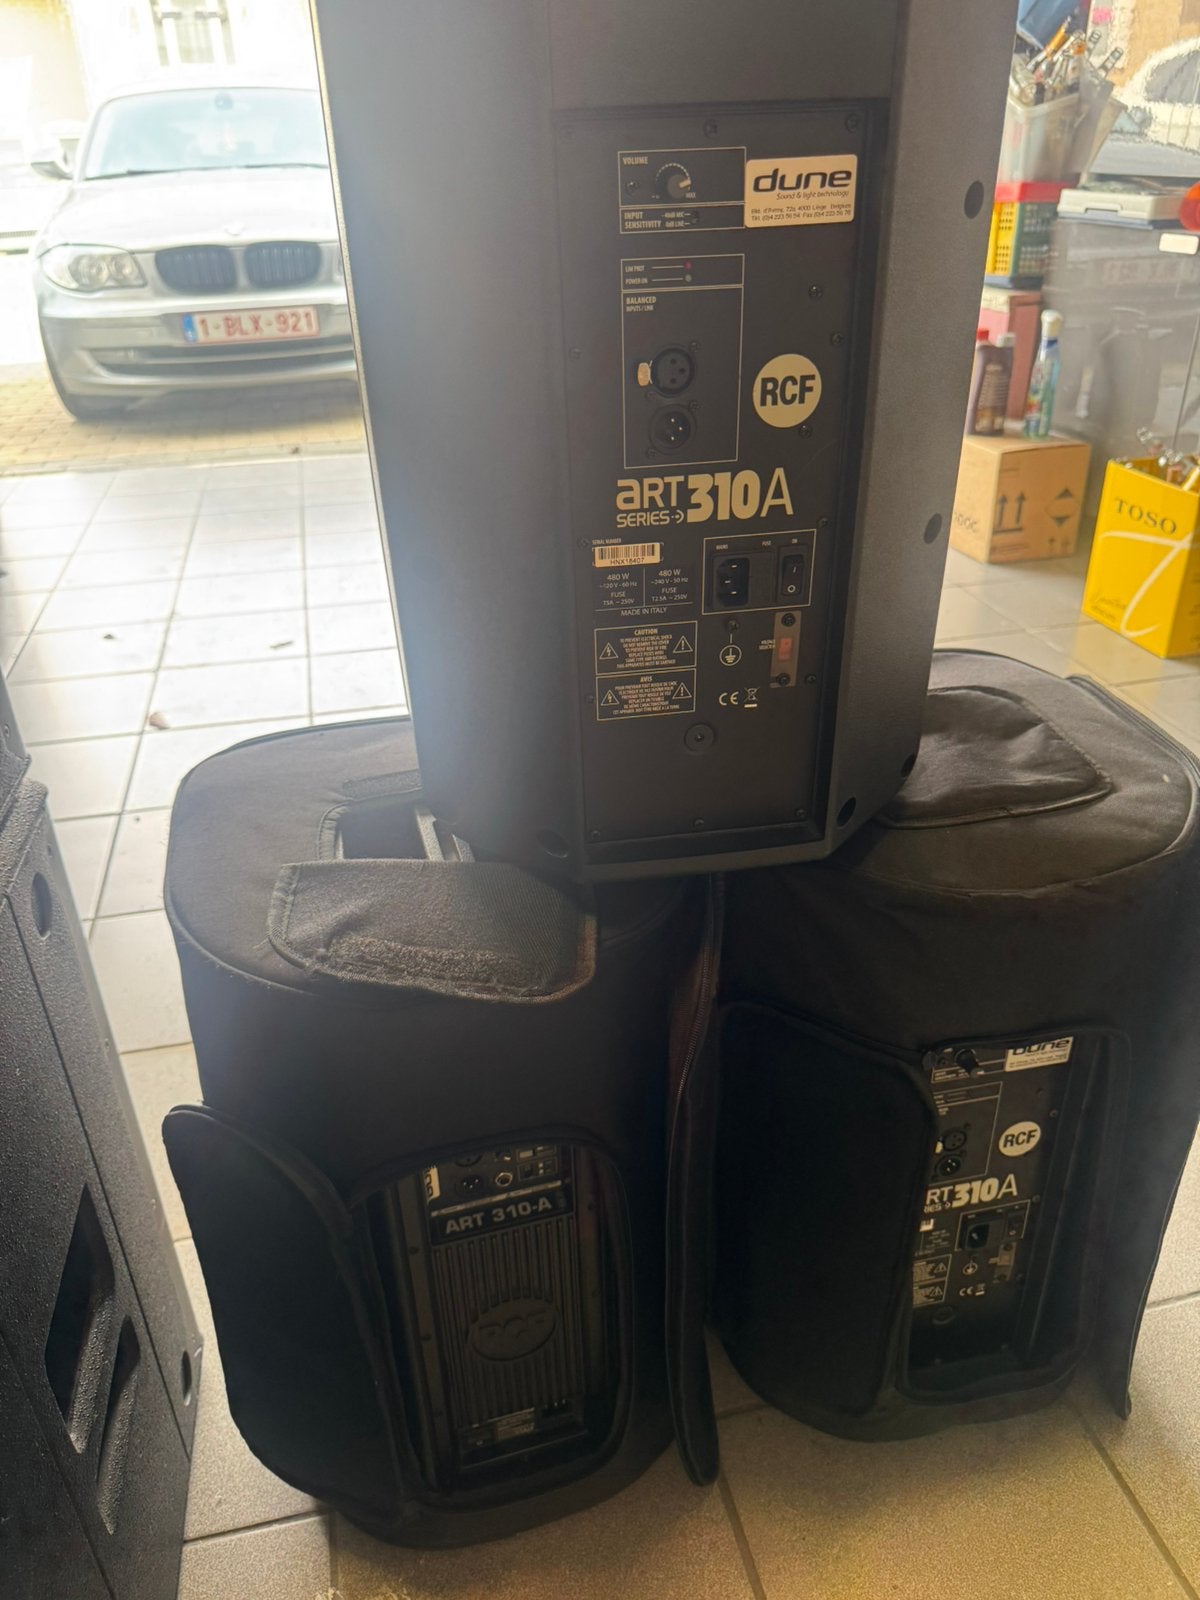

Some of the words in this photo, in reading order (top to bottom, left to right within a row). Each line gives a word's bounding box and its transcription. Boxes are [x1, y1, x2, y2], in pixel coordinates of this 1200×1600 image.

[622, 156, 648, 165] VOLUME
[753, 168, 852, 193] dune
[776, 192, 795, 200] Sound
[803, 191, 816, 200] light
[624, 212, 643, 220] INPUT
[624, 220, 662, 229] SENSITIVITY
[626, 296, 657, 305] BALANCED
[760, 374, 816, 407] RCF
[616, 511, 670, 528] SERIES
[1115, 497, 1177, 535] TOSO
[607, 574, 620, 582] 480
[634, 628, 658, 636] CAUTION
[1002, 1128, 1038, 1149] RCF
[446, 1212, 485, 1234] ART
[491, 1196, 552, 1222] 310-A
